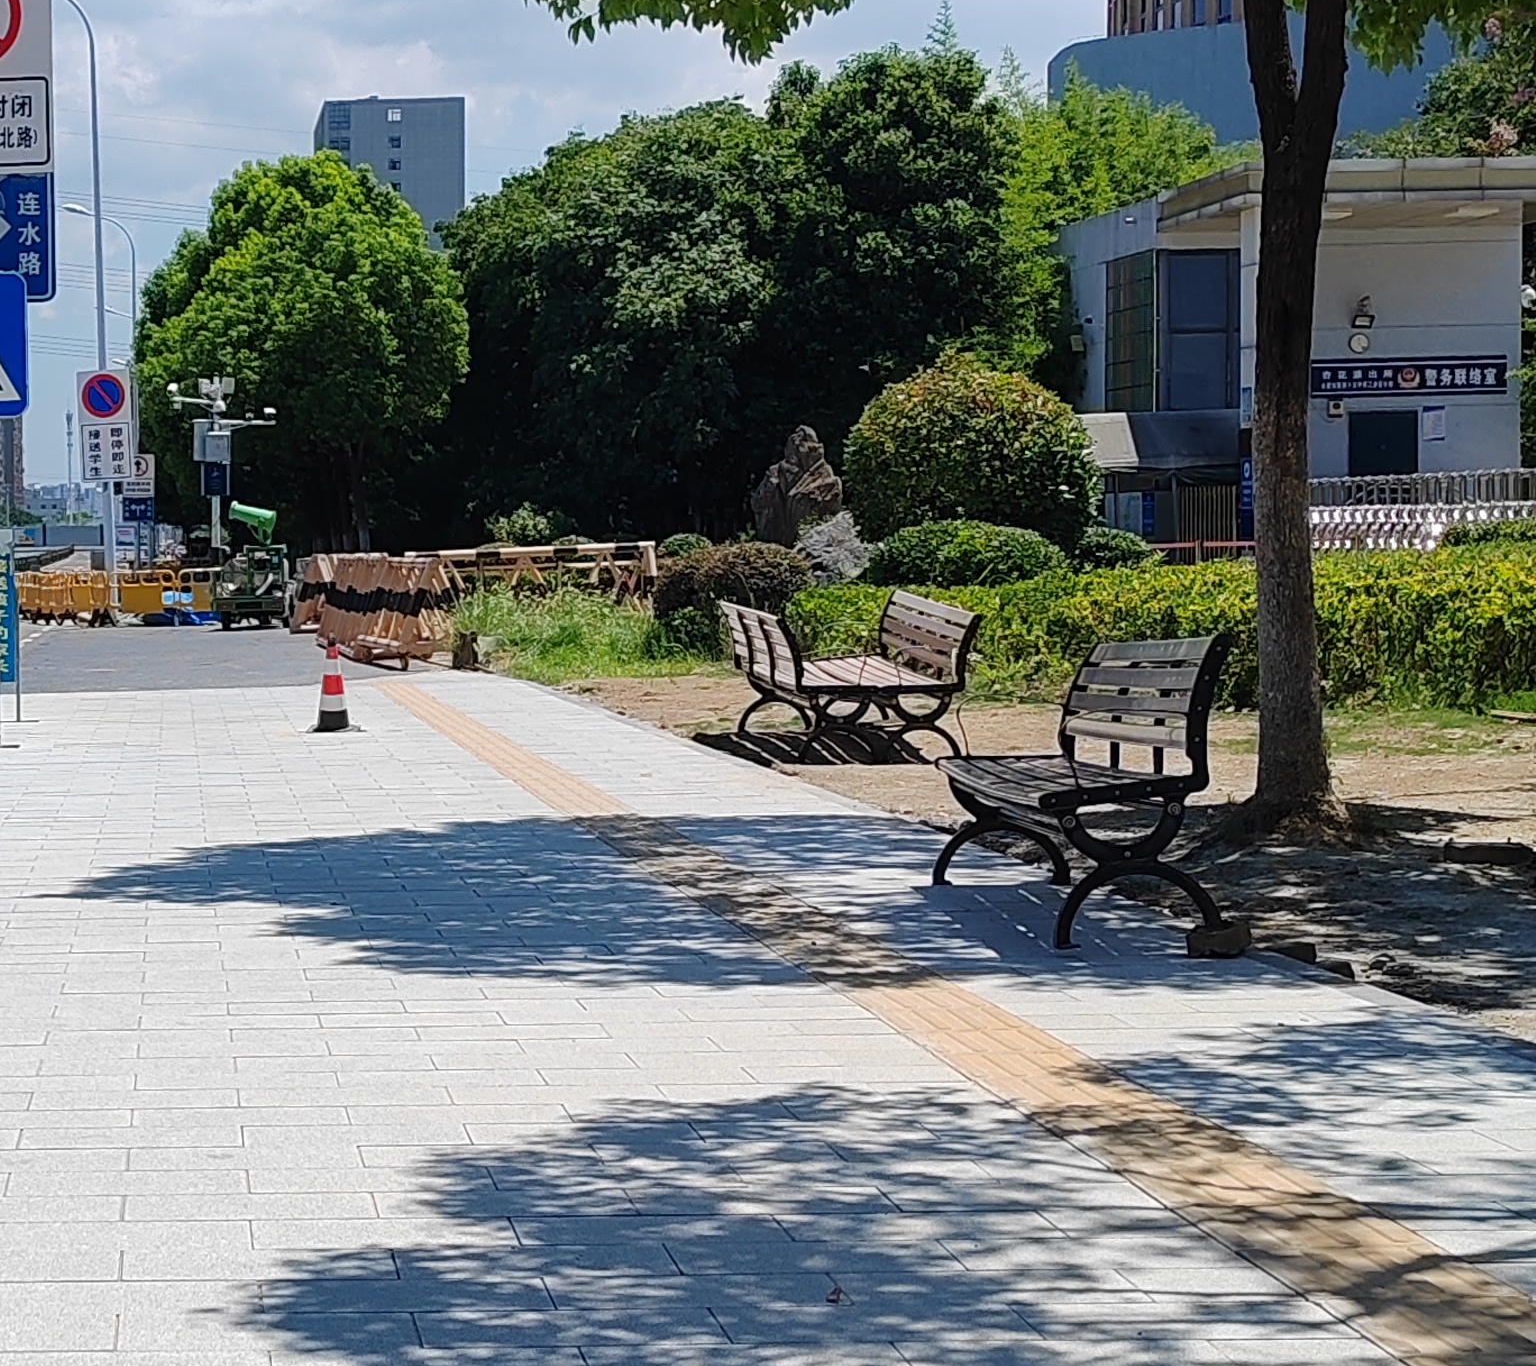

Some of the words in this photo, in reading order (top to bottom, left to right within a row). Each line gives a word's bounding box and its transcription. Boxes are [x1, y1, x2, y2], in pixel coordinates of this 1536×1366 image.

[17, 192, 42, 276] 连水路
[1424, 367, 1498, 387] 警务联络室
[88, 429, 103, 477] 接送学生
[110, 427, 126, 475] 即停即走
